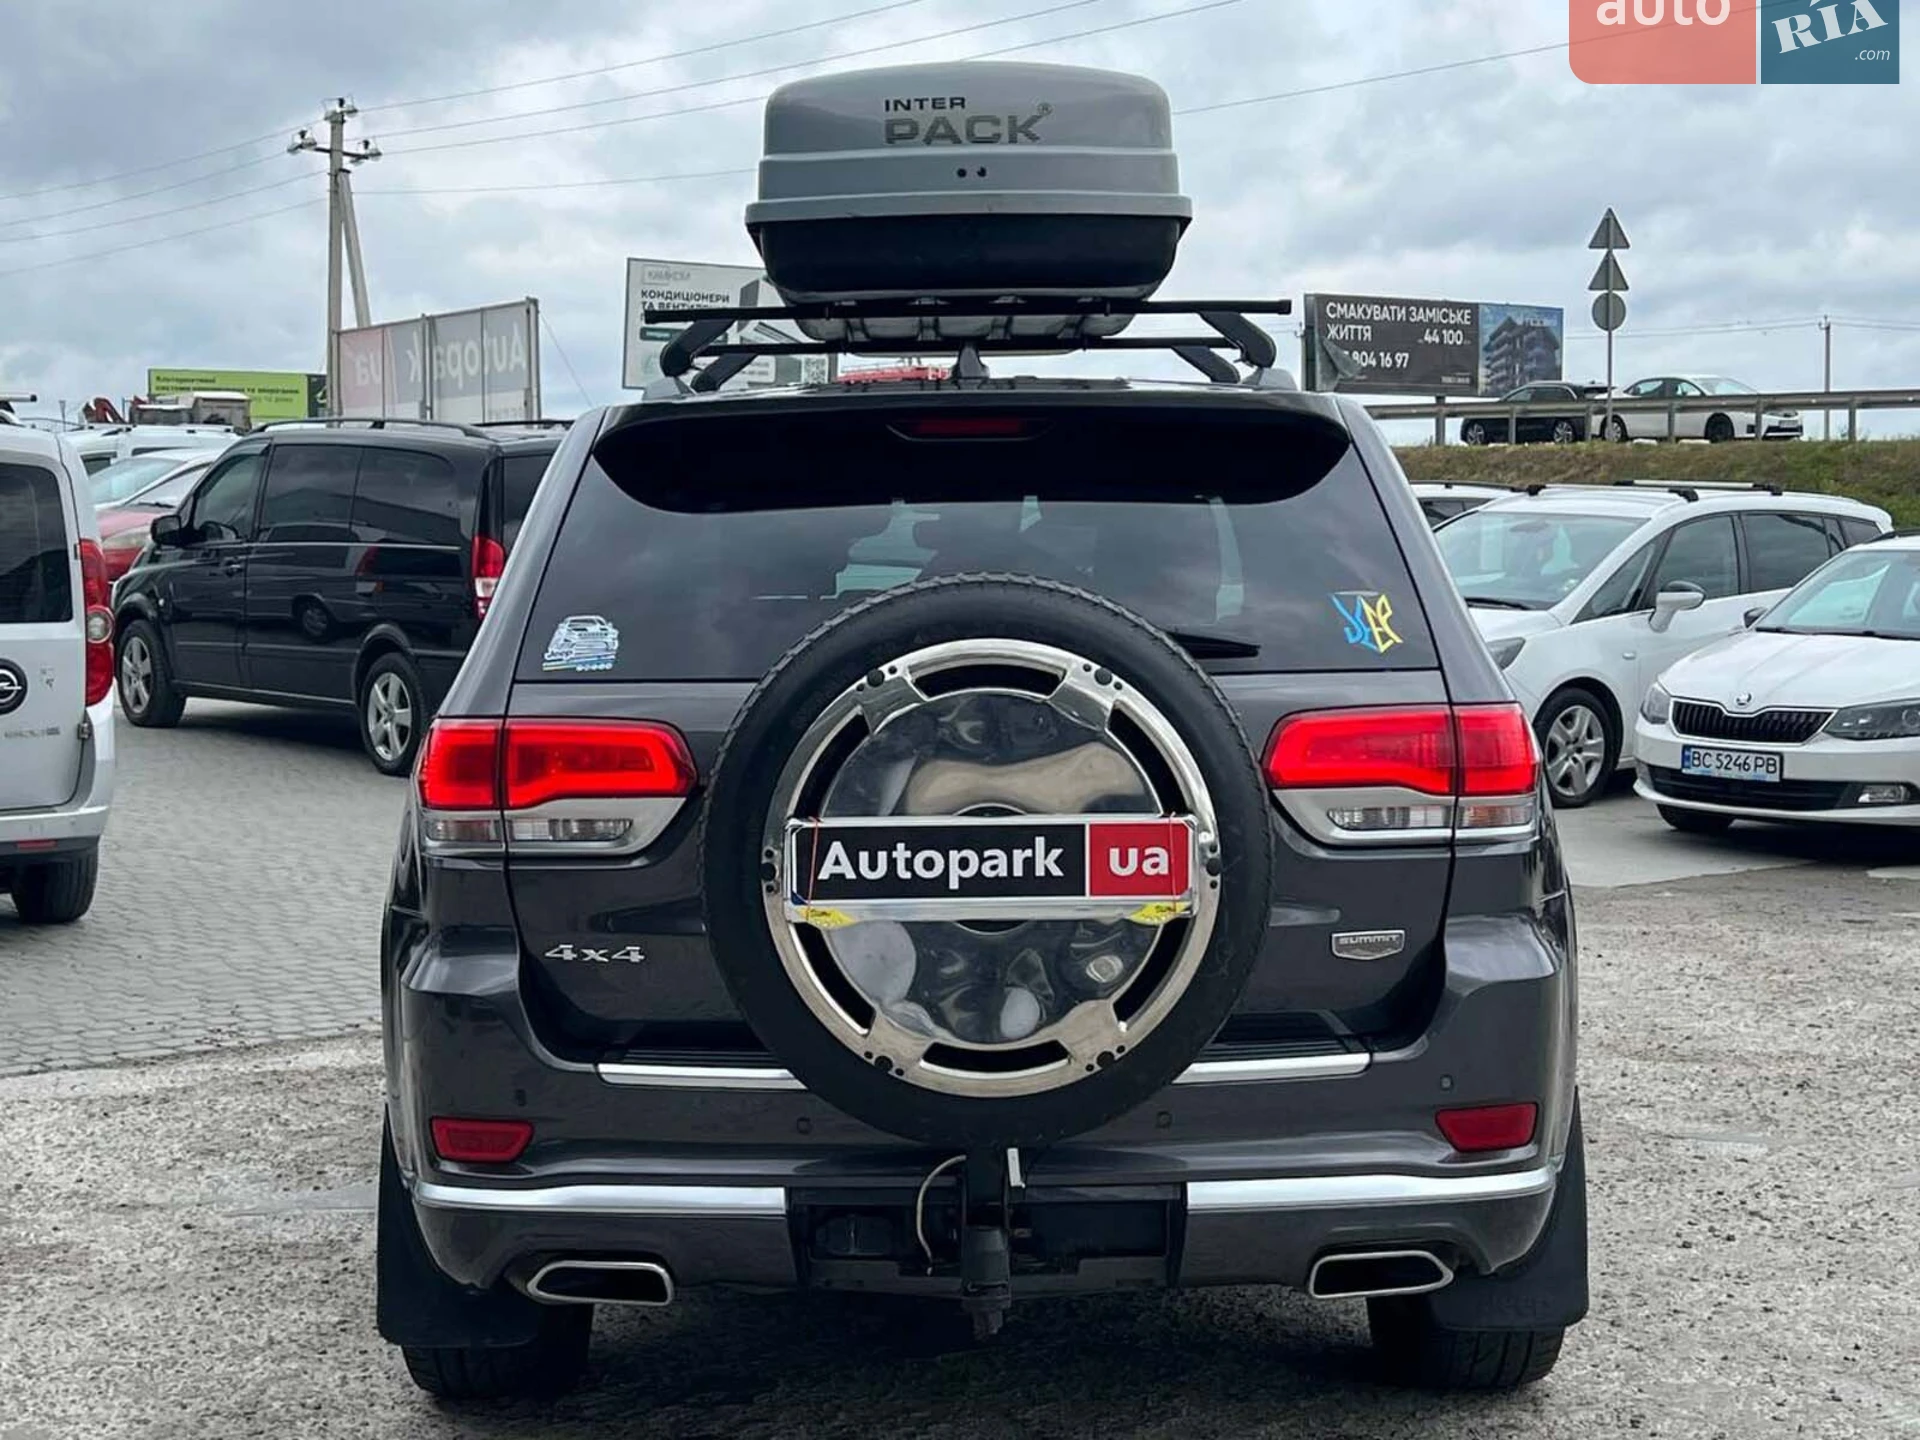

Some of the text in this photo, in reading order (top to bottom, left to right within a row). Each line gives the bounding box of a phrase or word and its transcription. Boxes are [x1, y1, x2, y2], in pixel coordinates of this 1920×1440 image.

[885, 97, 966, 112] INTER
[885, 115, 1041, 146] PACK
[641, 289, 730, 304] КОНДИЦІОНЕРИ
[1326, 302, 1471, 325] СМАКУВАТИ ЗАМІСЬКЕ
[1326, 324, 1372, 342] ЖИТТЯ
[1423, 328, 1464, 346] 44 100
[1379, 351, 1393, 368] 16
[1395, 352, 1409, 368] 97
[1691, 751, 1778, 774] BC 5246 PB
[817, 836, 1170, 890] Autopark ua
[544, 944, 646, 963] 4x4
